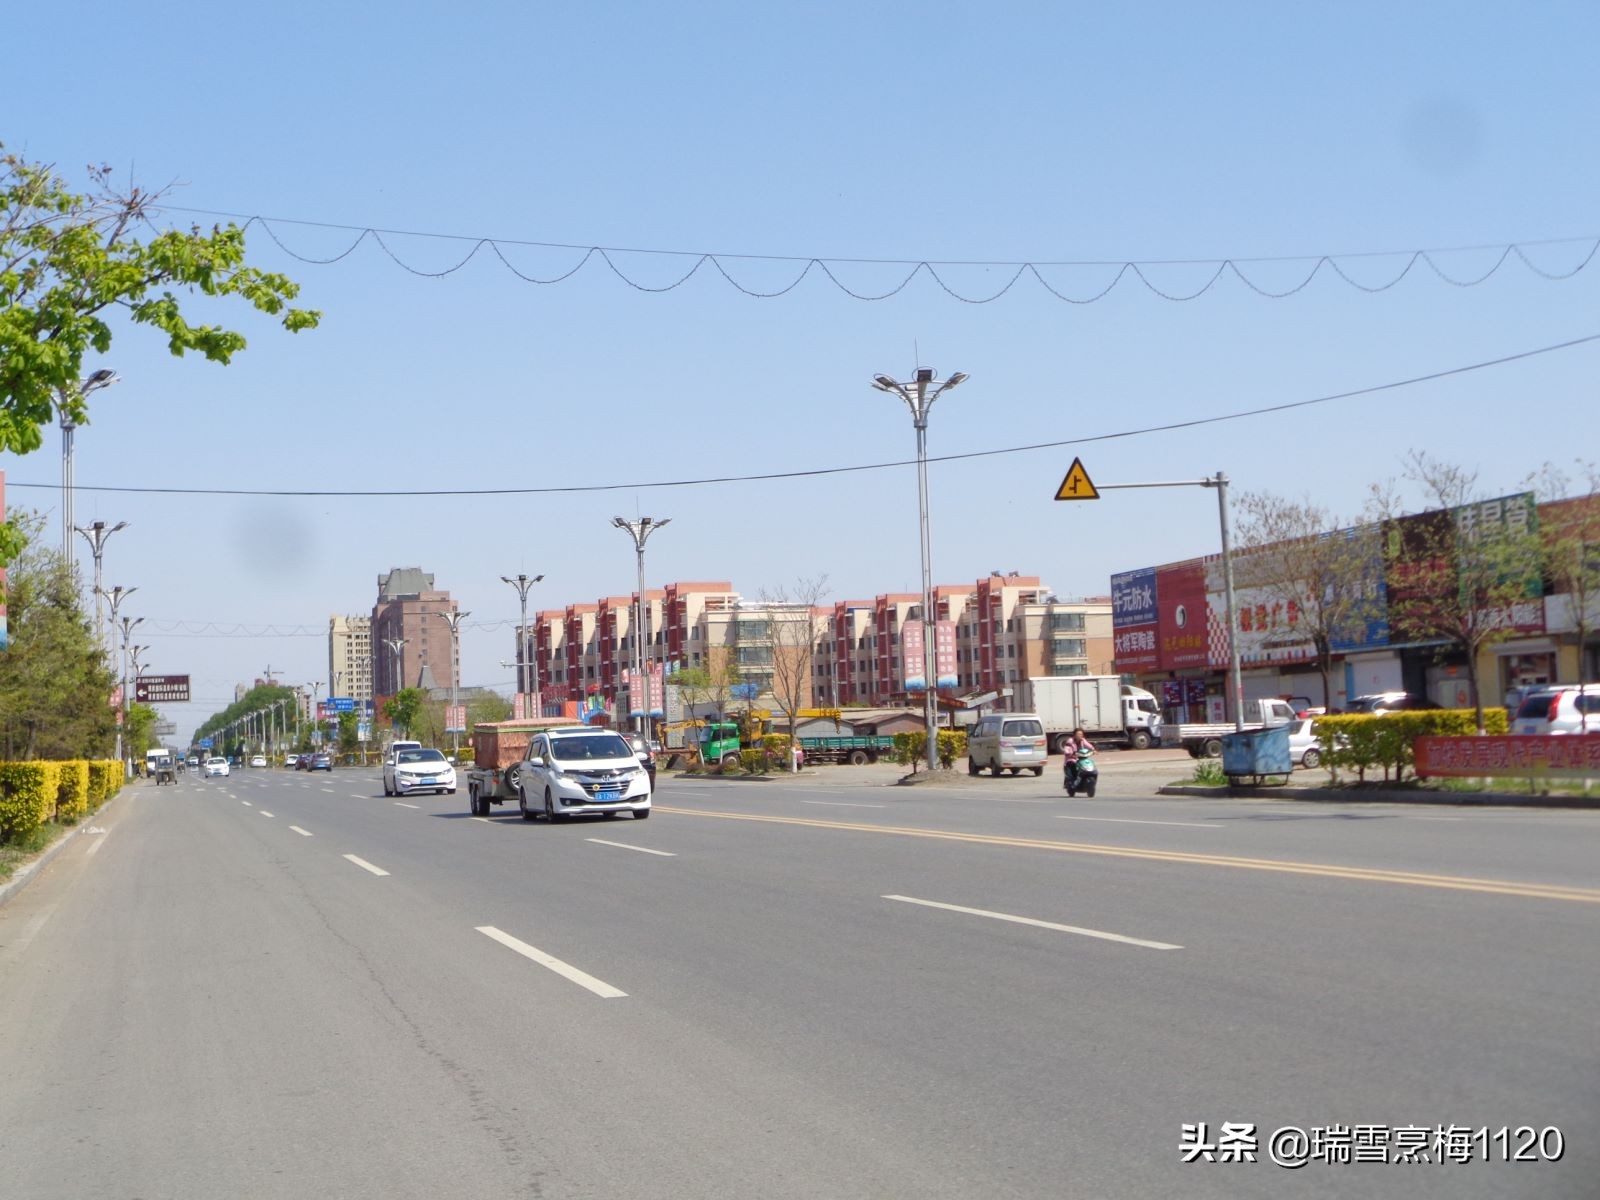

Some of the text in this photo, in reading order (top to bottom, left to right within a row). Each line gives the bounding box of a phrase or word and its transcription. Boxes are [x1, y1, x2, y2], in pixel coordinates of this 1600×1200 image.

[1113, 584, 1152, 613] 牛元防水
[1115, 630, 1155, 653] 大将军陶瓷
